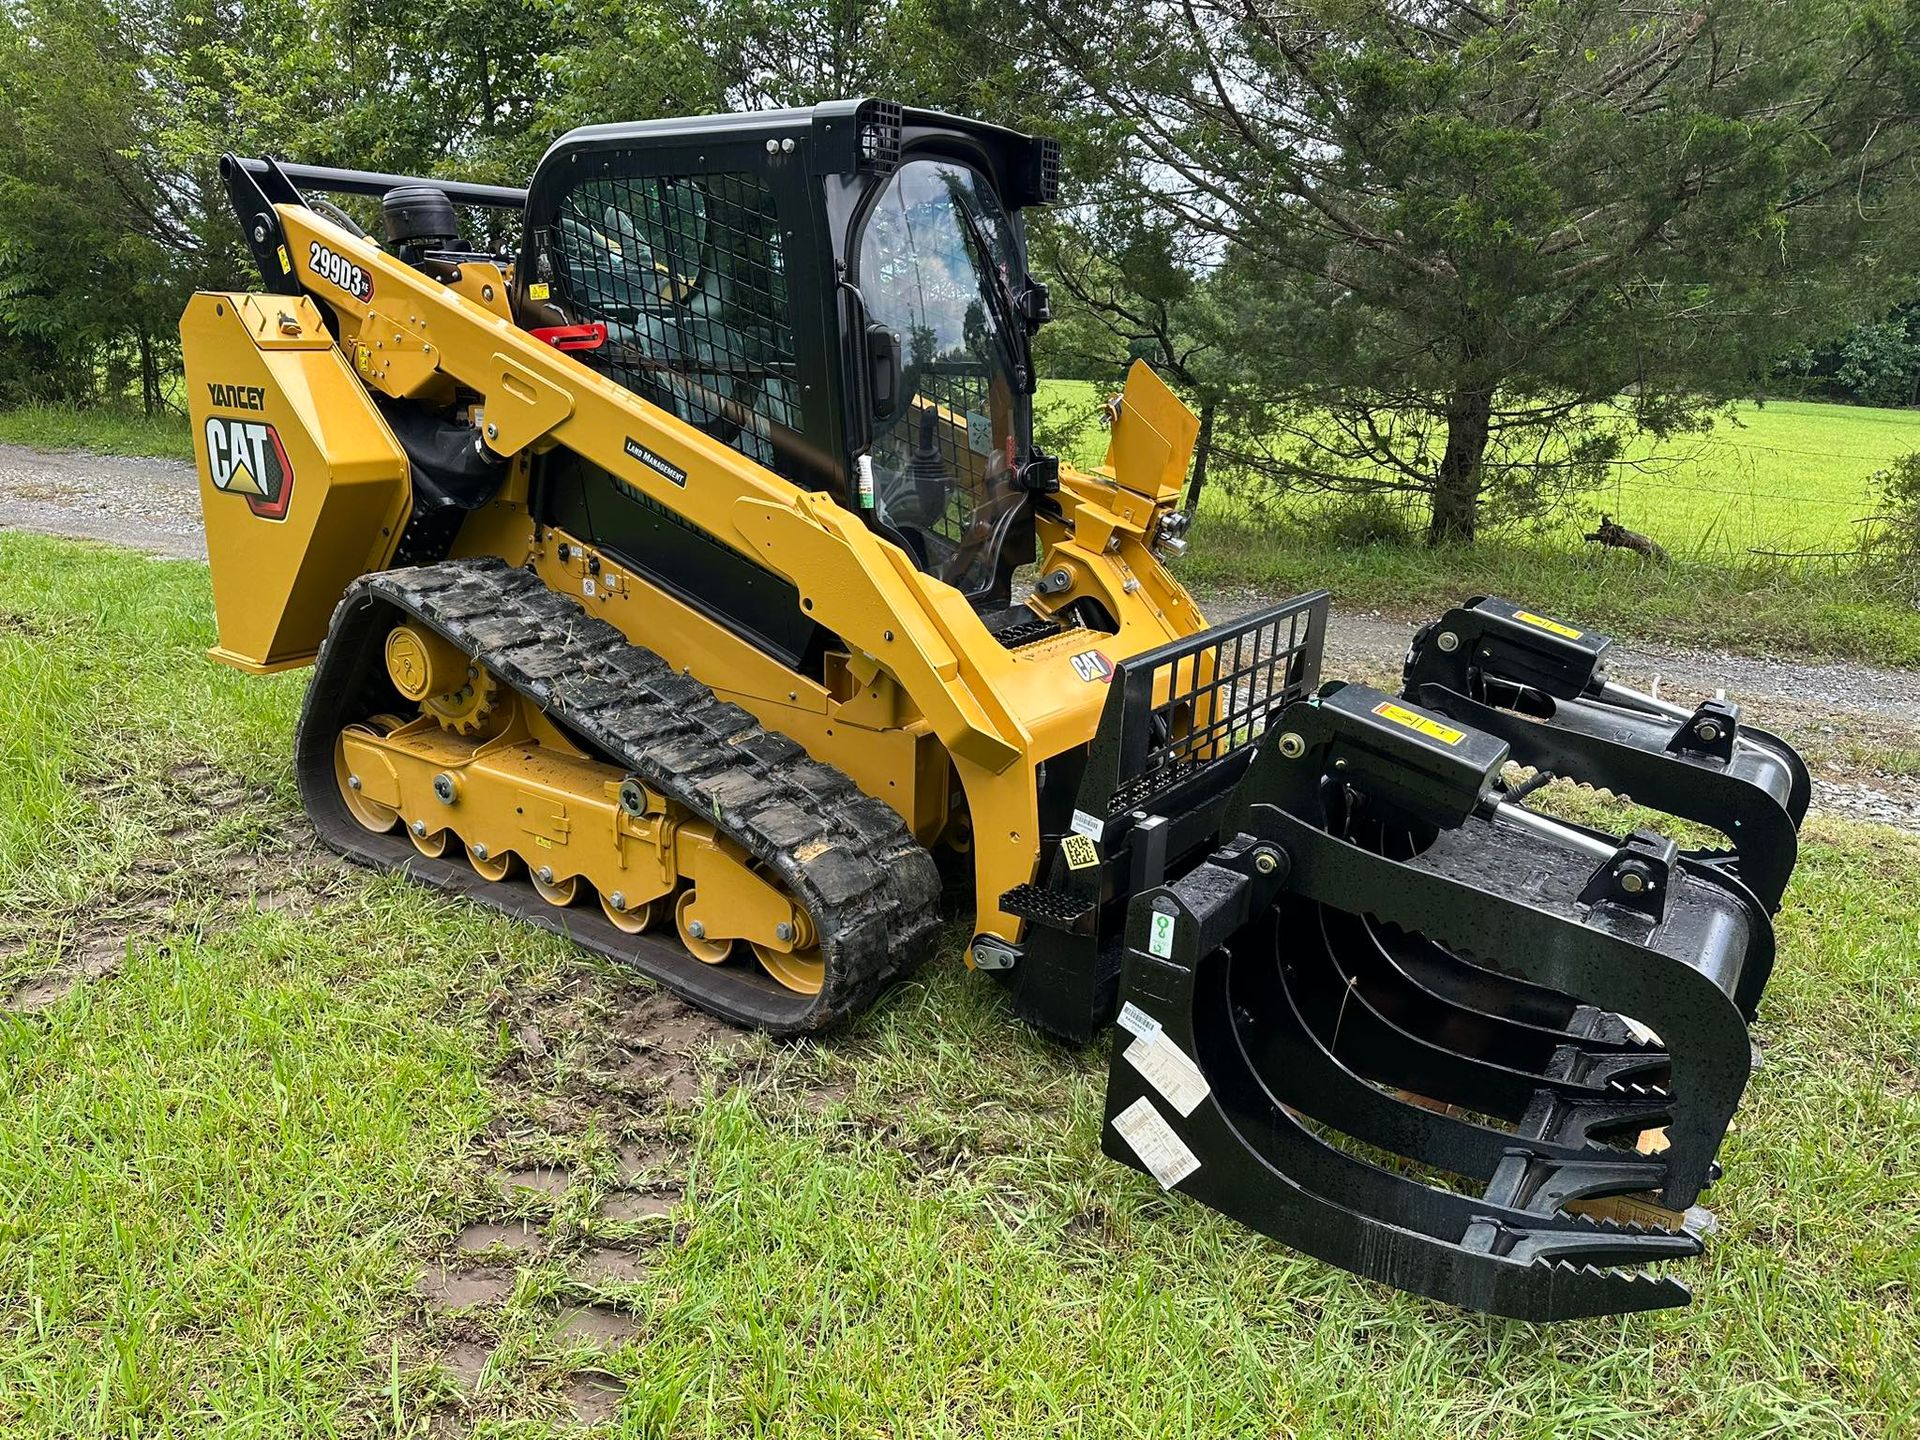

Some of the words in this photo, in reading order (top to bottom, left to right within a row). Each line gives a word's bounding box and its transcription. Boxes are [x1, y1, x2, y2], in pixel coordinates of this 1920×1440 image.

[309, 242, 361, 296] 299D3
[207, 383, 265, 411] YANCEY
[206, 418, 269, 496] CAT
[1070, 650, 1108, 682] CAT
